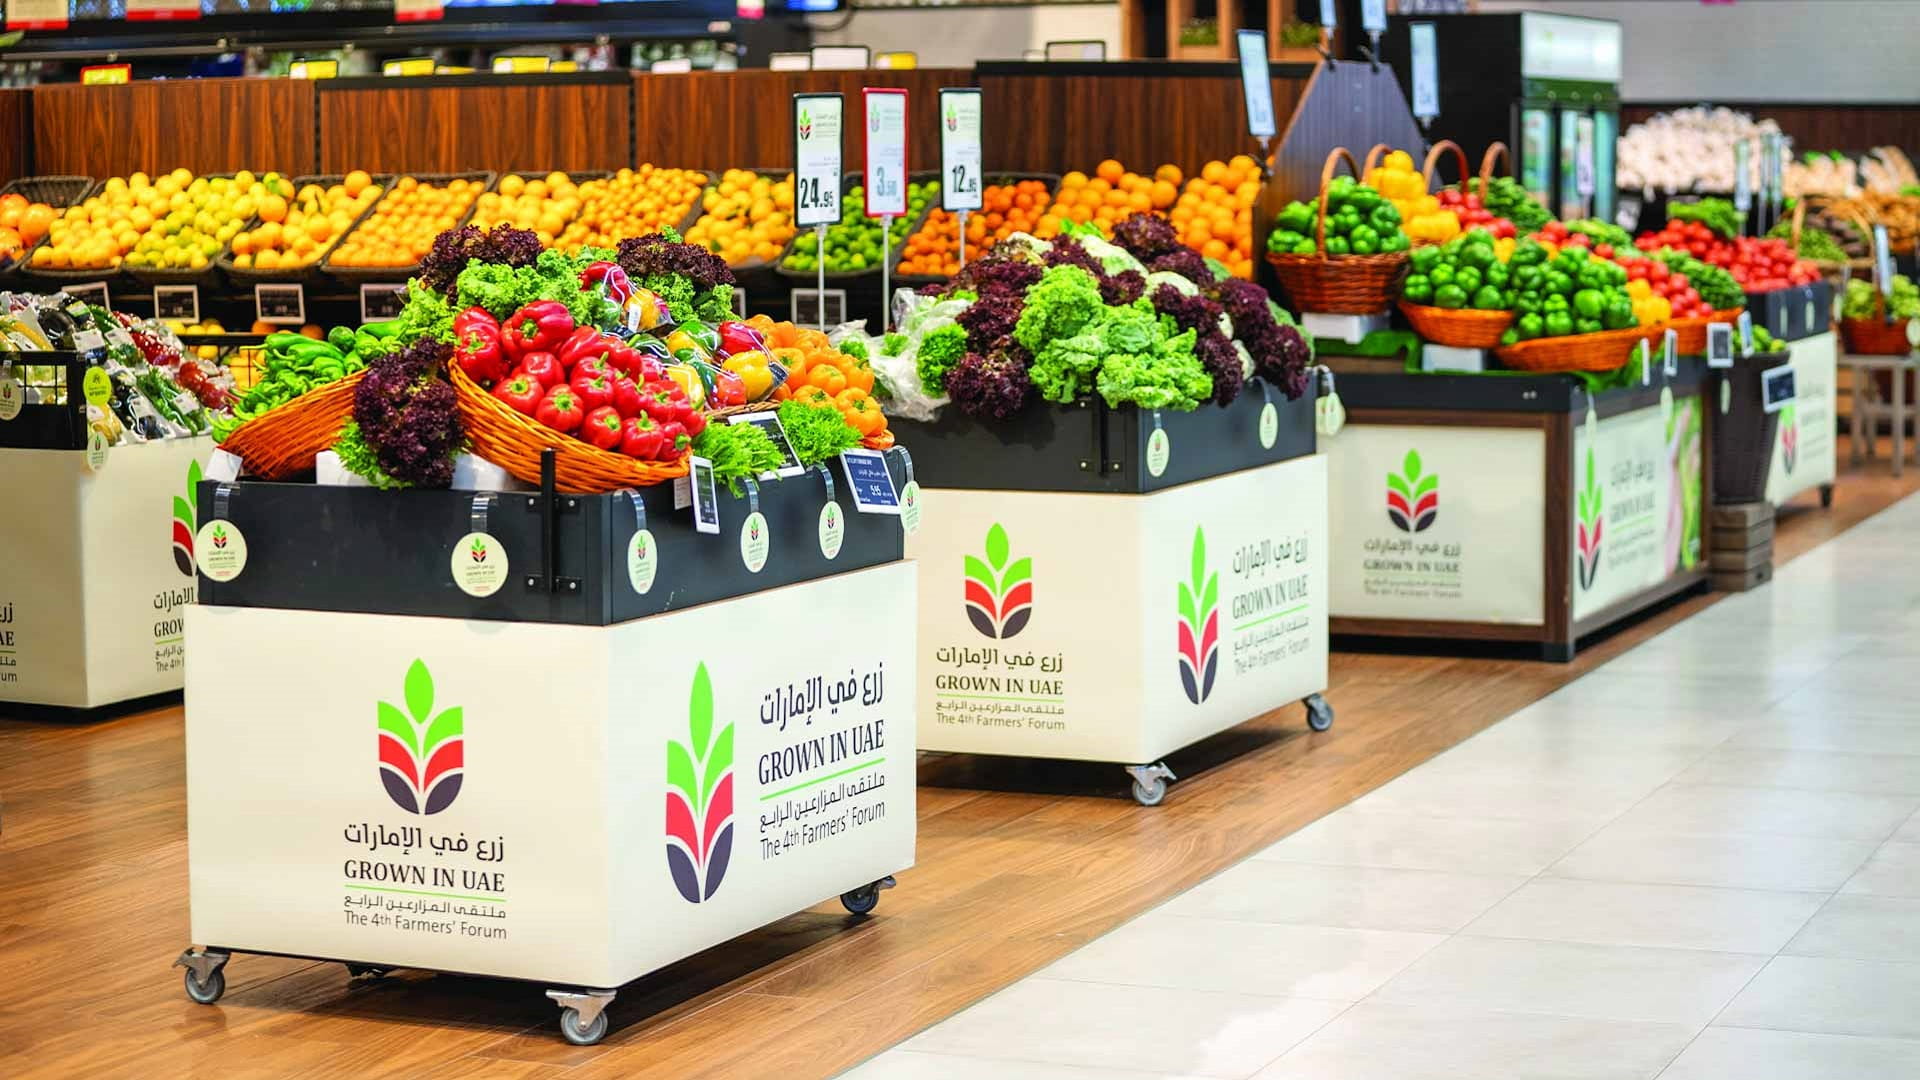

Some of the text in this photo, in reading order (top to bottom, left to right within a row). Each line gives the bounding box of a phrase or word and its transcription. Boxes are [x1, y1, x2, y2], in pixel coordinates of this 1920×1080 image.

[800, 177, 833, 208] 24.95
[1232, 574, 1308, 619] GROWN IN UAE
[936, 646, 1063, 673] زرع في الإمارات
[760, 661, 884, 732] زرع في الإمارات
[936, 674, 1063, 695] GROWN IN UAE
[936, 712, 955, 724] The
[1028, 717, 1065, 731] Forum
[758, 719, 885, 785] GROWN IN UAE
[760, 771, 885, 833] ملتقى المزارعين الرابع
[344, 823, 504, 862] زرع في الإمارات
[760, 838, 781, 860] The
[783, 828, 800, 852] 4th
[852, 801, 885, 828] Forum
[344, 859, 505, 892] GROWN IN UAE
[344, 894, 507, 918] ملتقى المزارعين الرابع
[344, 910, 368, 926] The
[371, 912, 392, 927] 4th
[461, 921, 507, 940] Forum
